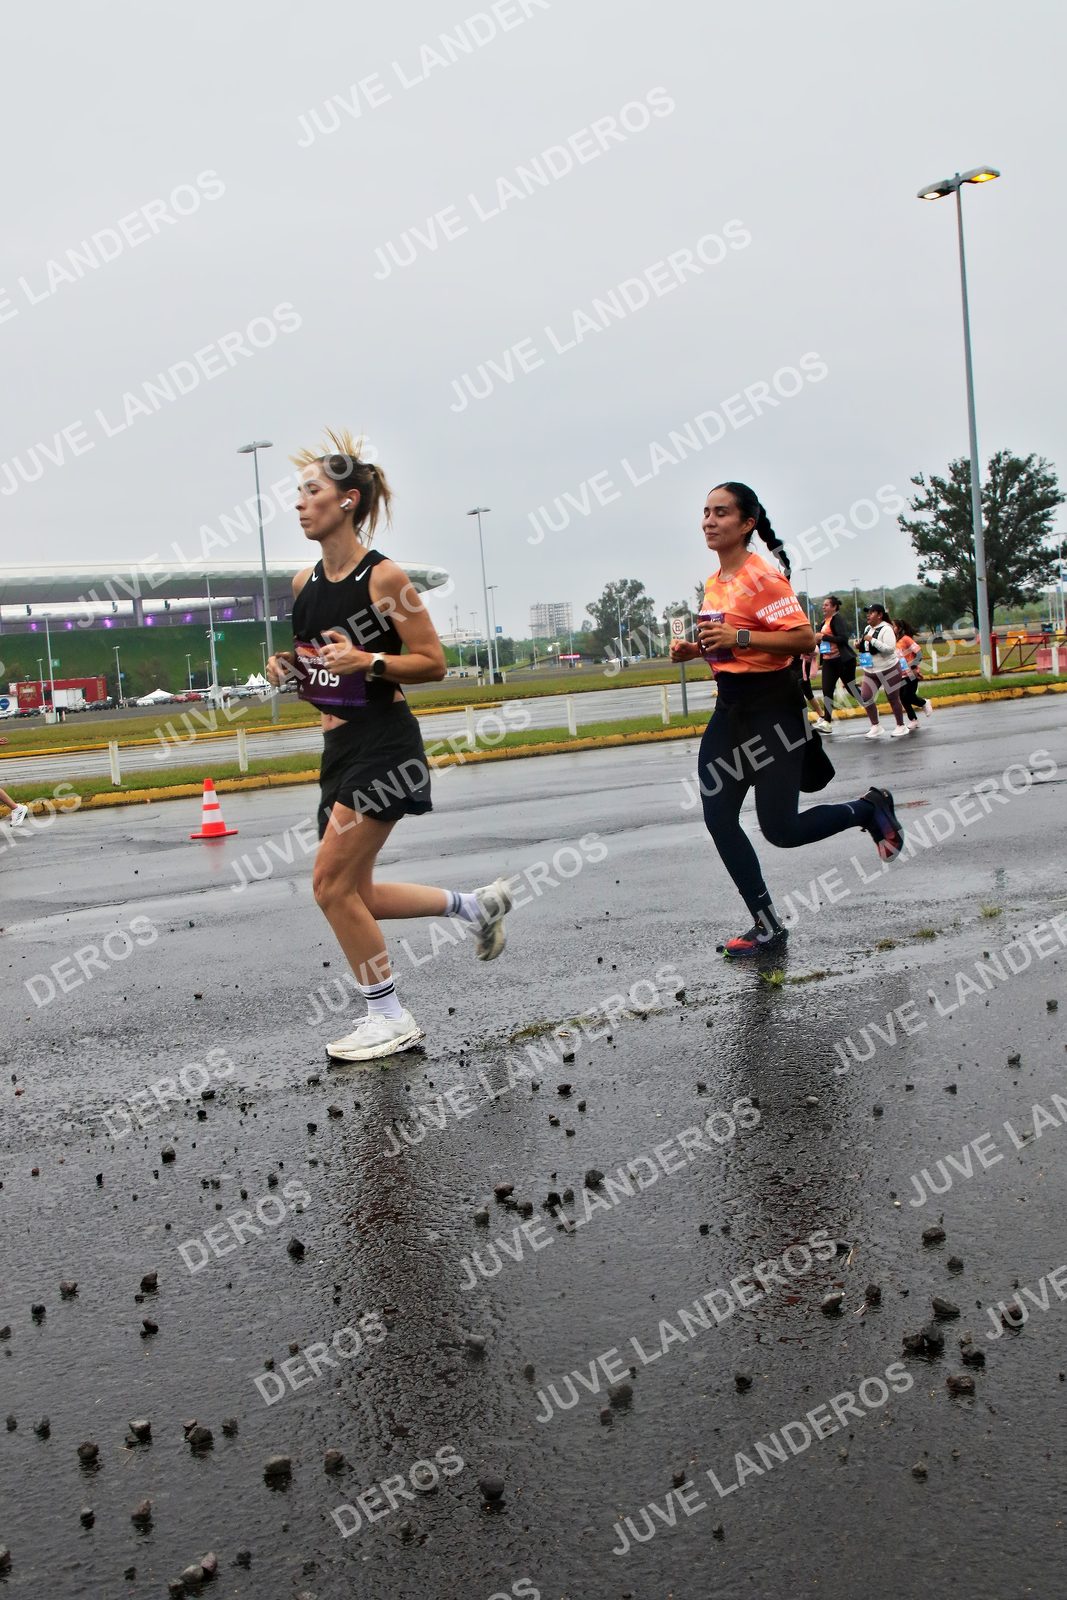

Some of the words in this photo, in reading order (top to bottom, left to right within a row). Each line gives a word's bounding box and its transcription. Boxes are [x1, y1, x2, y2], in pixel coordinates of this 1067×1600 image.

[755, 597, 791, 620] NUTRICIÓN
[765, 605, 795, 625] IMPULSA
[308, 668, 340, 687] 709
